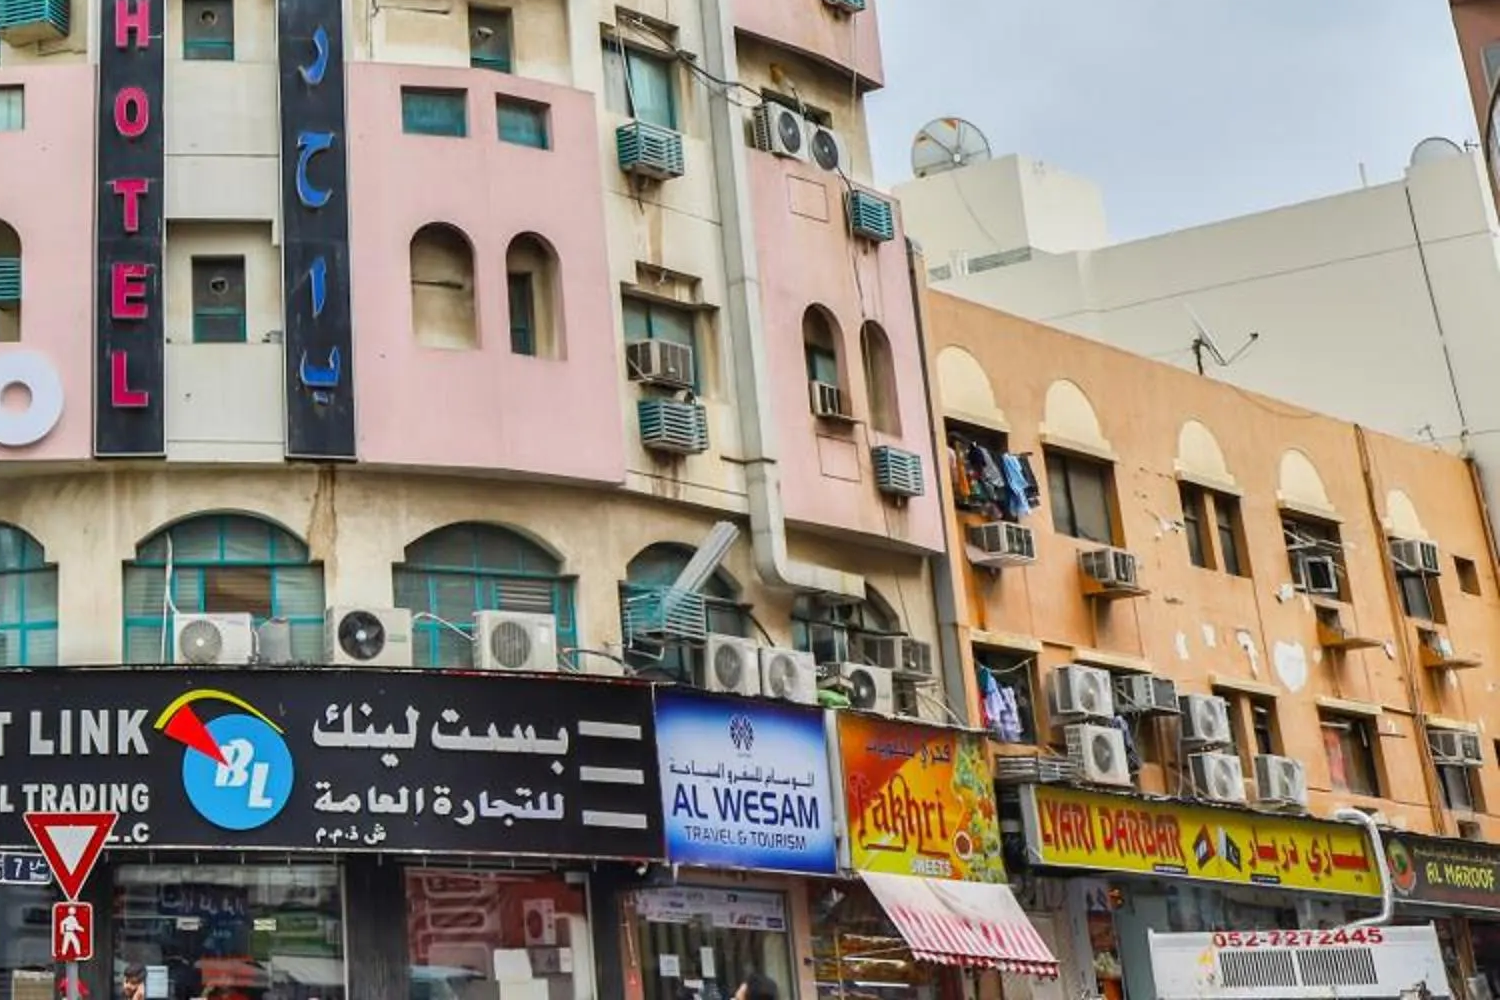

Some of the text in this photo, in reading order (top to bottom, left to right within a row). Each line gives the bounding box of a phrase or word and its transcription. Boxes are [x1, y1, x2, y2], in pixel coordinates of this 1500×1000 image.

[29, 709, 150, 755] LINK
[312, 702, 570, 775] بست لينك
[215, 738, 273, 808] BL
[22, 783, 150, 813] TRADING
[314, 781, 564, 827] للتجارة العامة
[672, 783, 820, 829] AL WESAM
[684, 825, 807, 850] TRAVEL & TOURISM
[13, 857, 23, 878] 7
